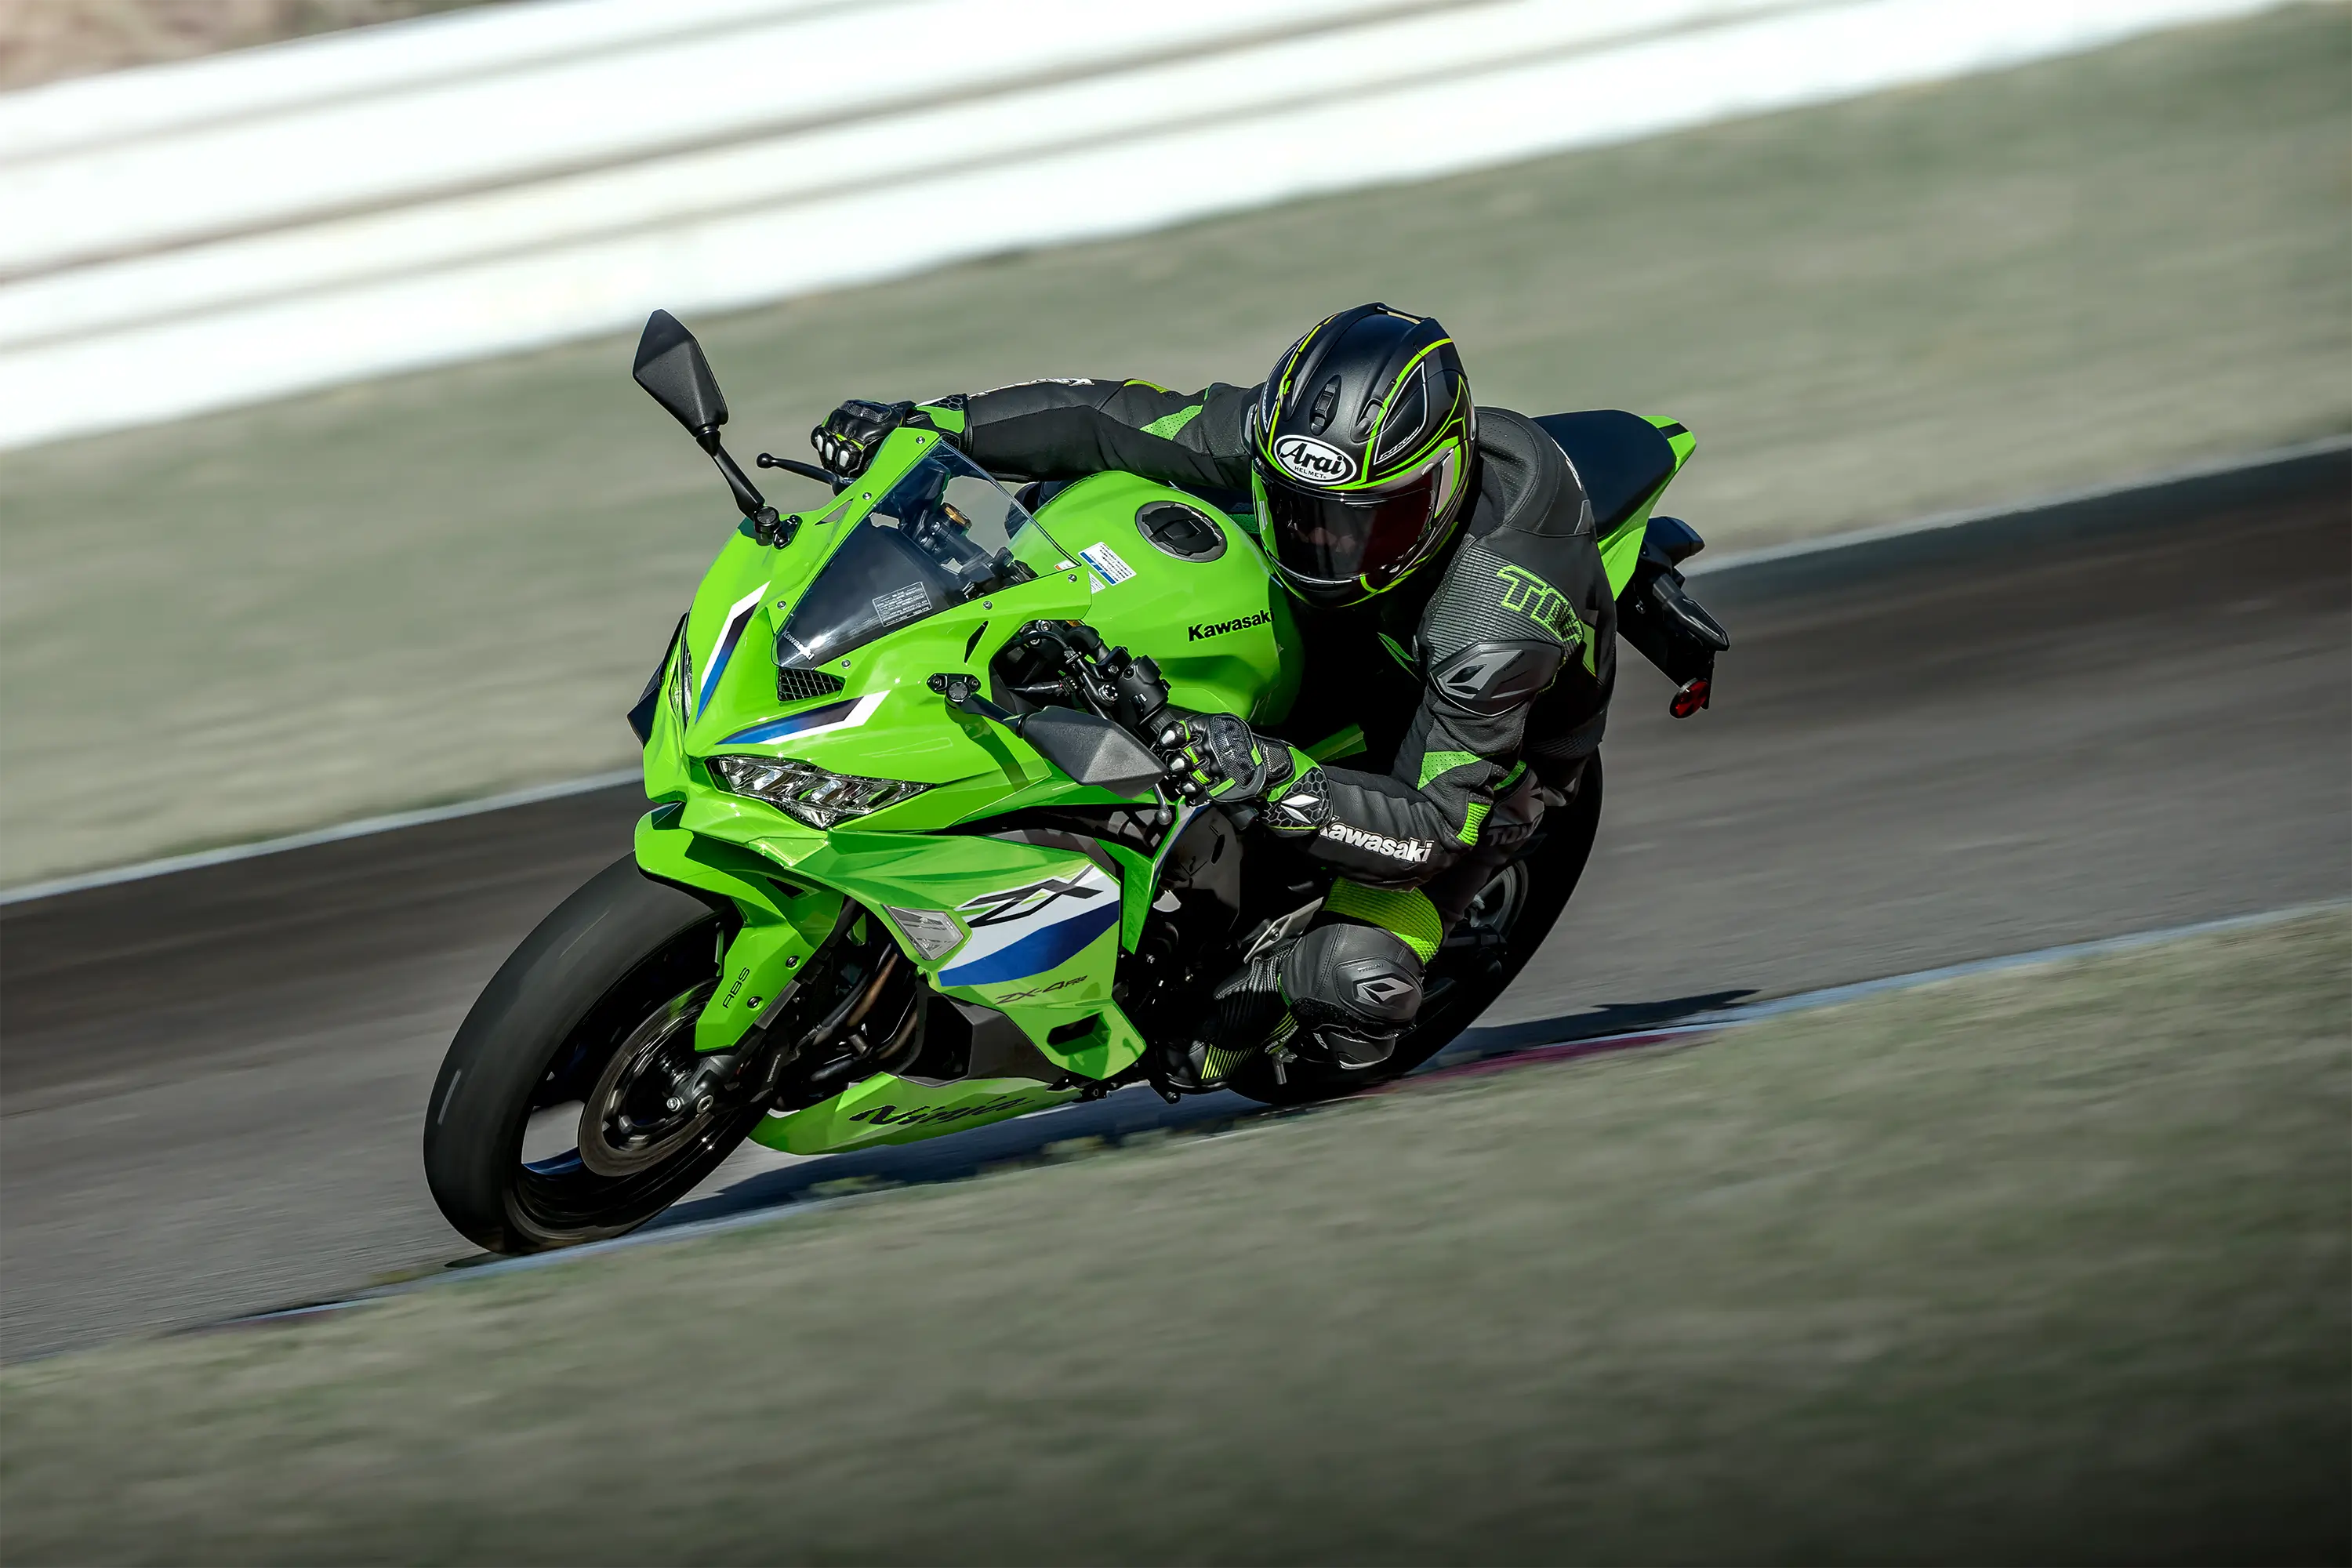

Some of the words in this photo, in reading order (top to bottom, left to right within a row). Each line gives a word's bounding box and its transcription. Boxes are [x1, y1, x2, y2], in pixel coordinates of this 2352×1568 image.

[1279, 442, 1344, 474] Arai
[1294, 466, 1323, 478] HELMET
[1188, 608, 1275, 641] Kawasaki
[782, 630, 815, 660] Kawaki
[960, 864, 1104, 928] ZX
[722, 967, 750, 1009] ABS
